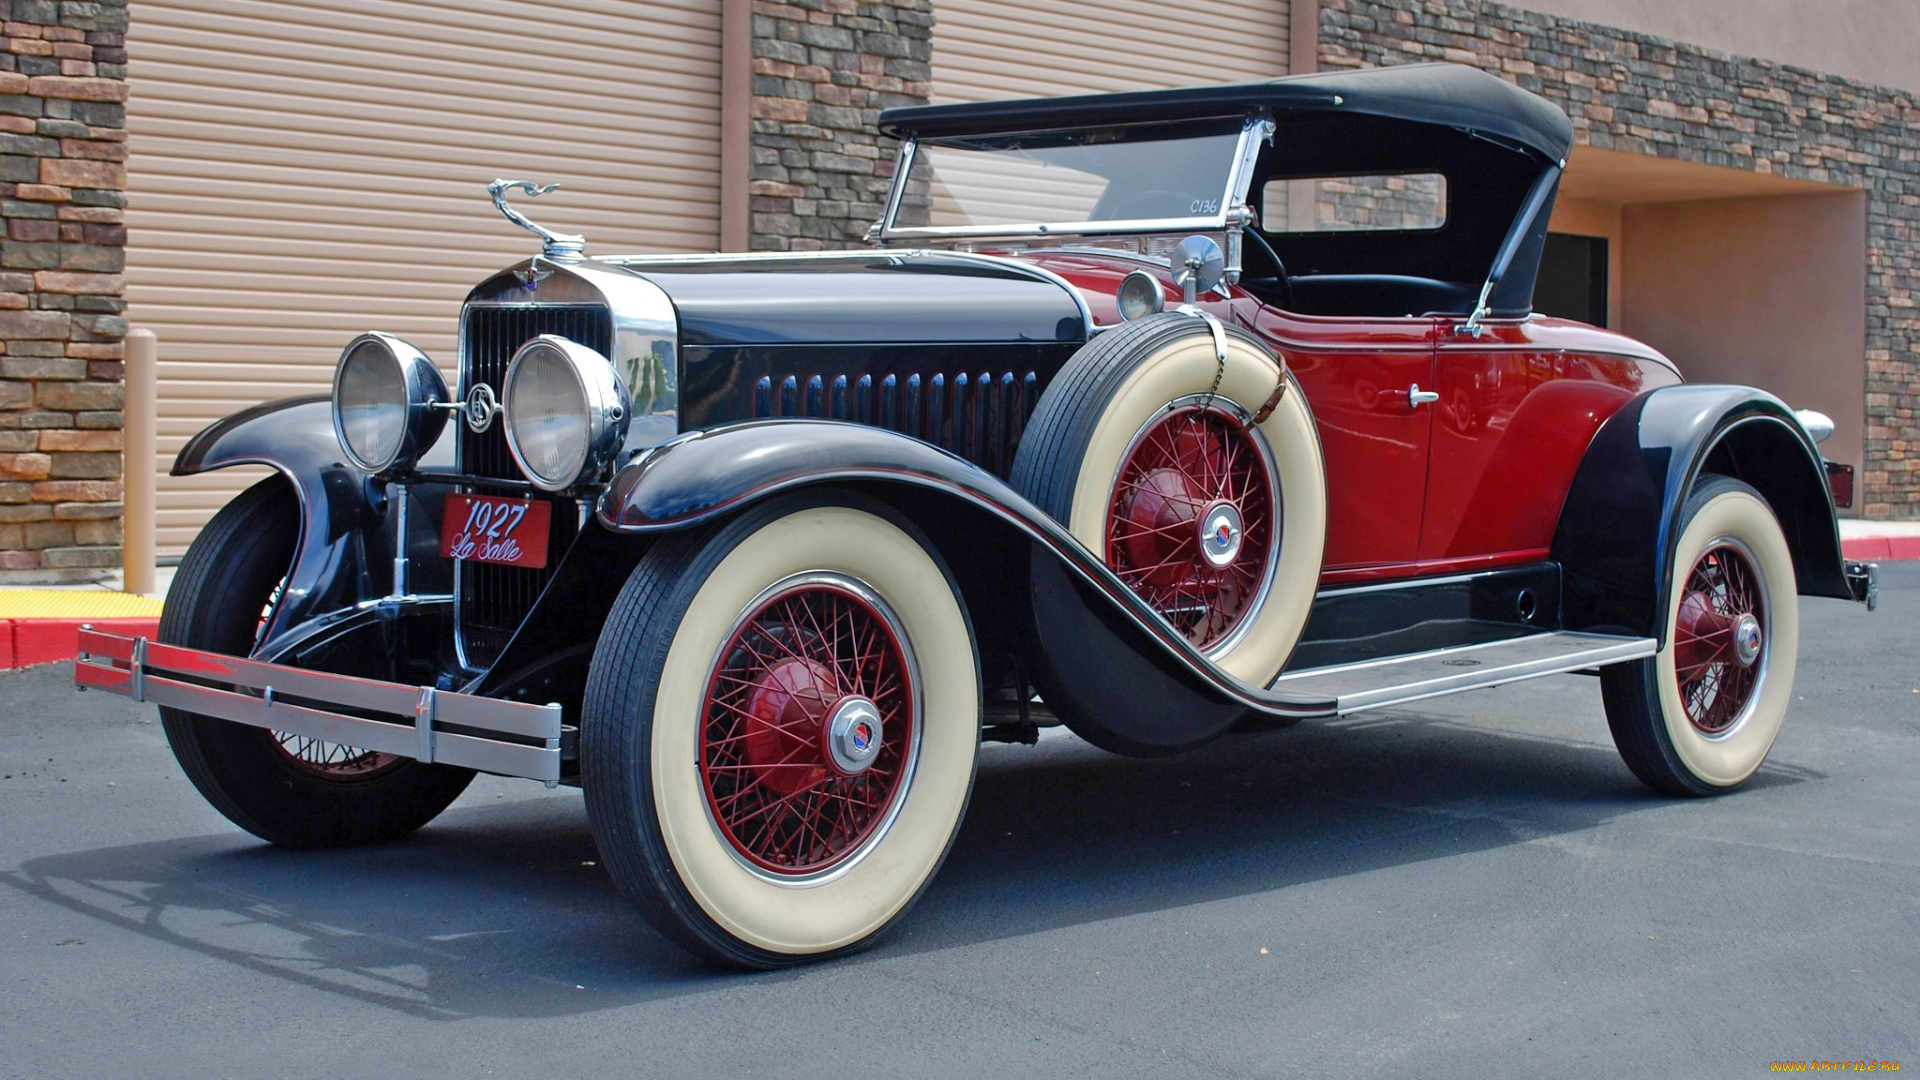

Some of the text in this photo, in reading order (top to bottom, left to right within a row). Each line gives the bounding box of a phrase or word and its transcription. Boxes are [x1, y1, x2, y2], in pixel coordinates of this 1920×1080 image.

[1190, 199, 1217, 213] C136
[464, 500, 525, 538] 1927
[450, 532, 523, 562] La Salle
